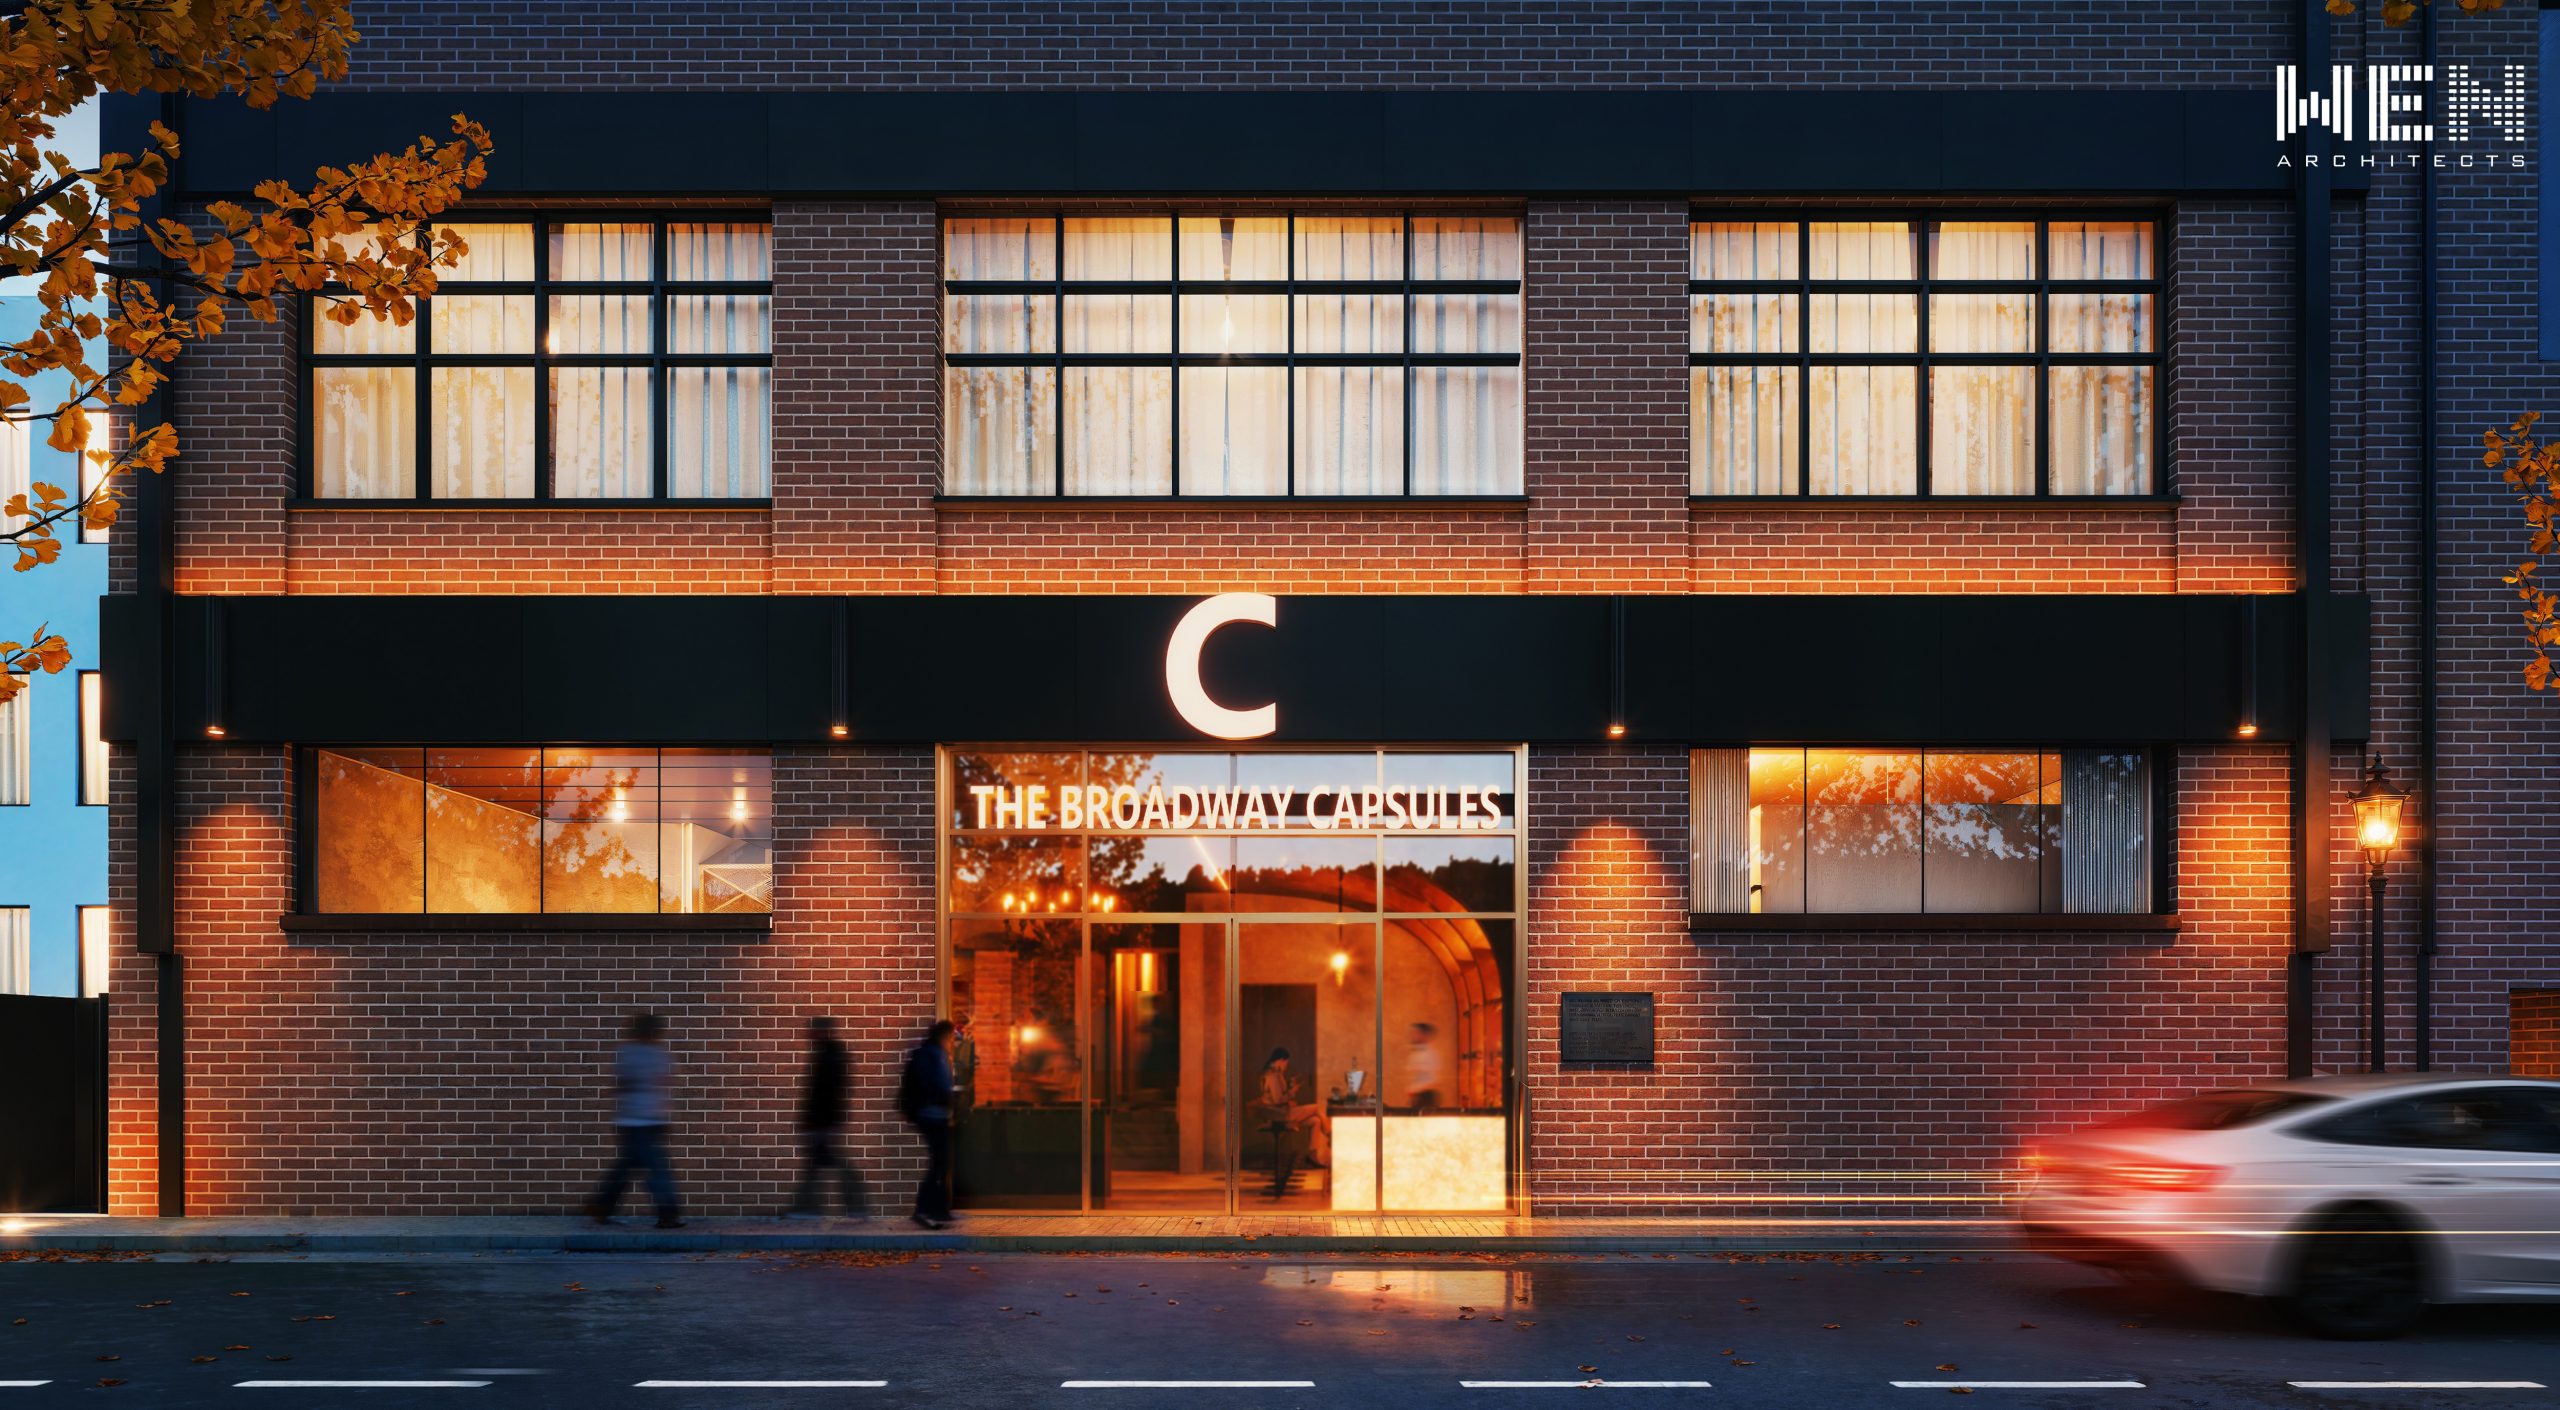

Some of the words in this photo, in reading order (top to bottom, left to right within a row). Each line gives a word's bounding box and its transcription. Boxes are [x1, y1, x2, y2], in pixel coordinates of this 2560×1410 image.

[1166, 592, 1277, 740] C
[970, 785, 1047, 829] THE
[1061, 785, 1294, 829] BROADWAY
[1306, 785, 1501, 829] CAPSULES
